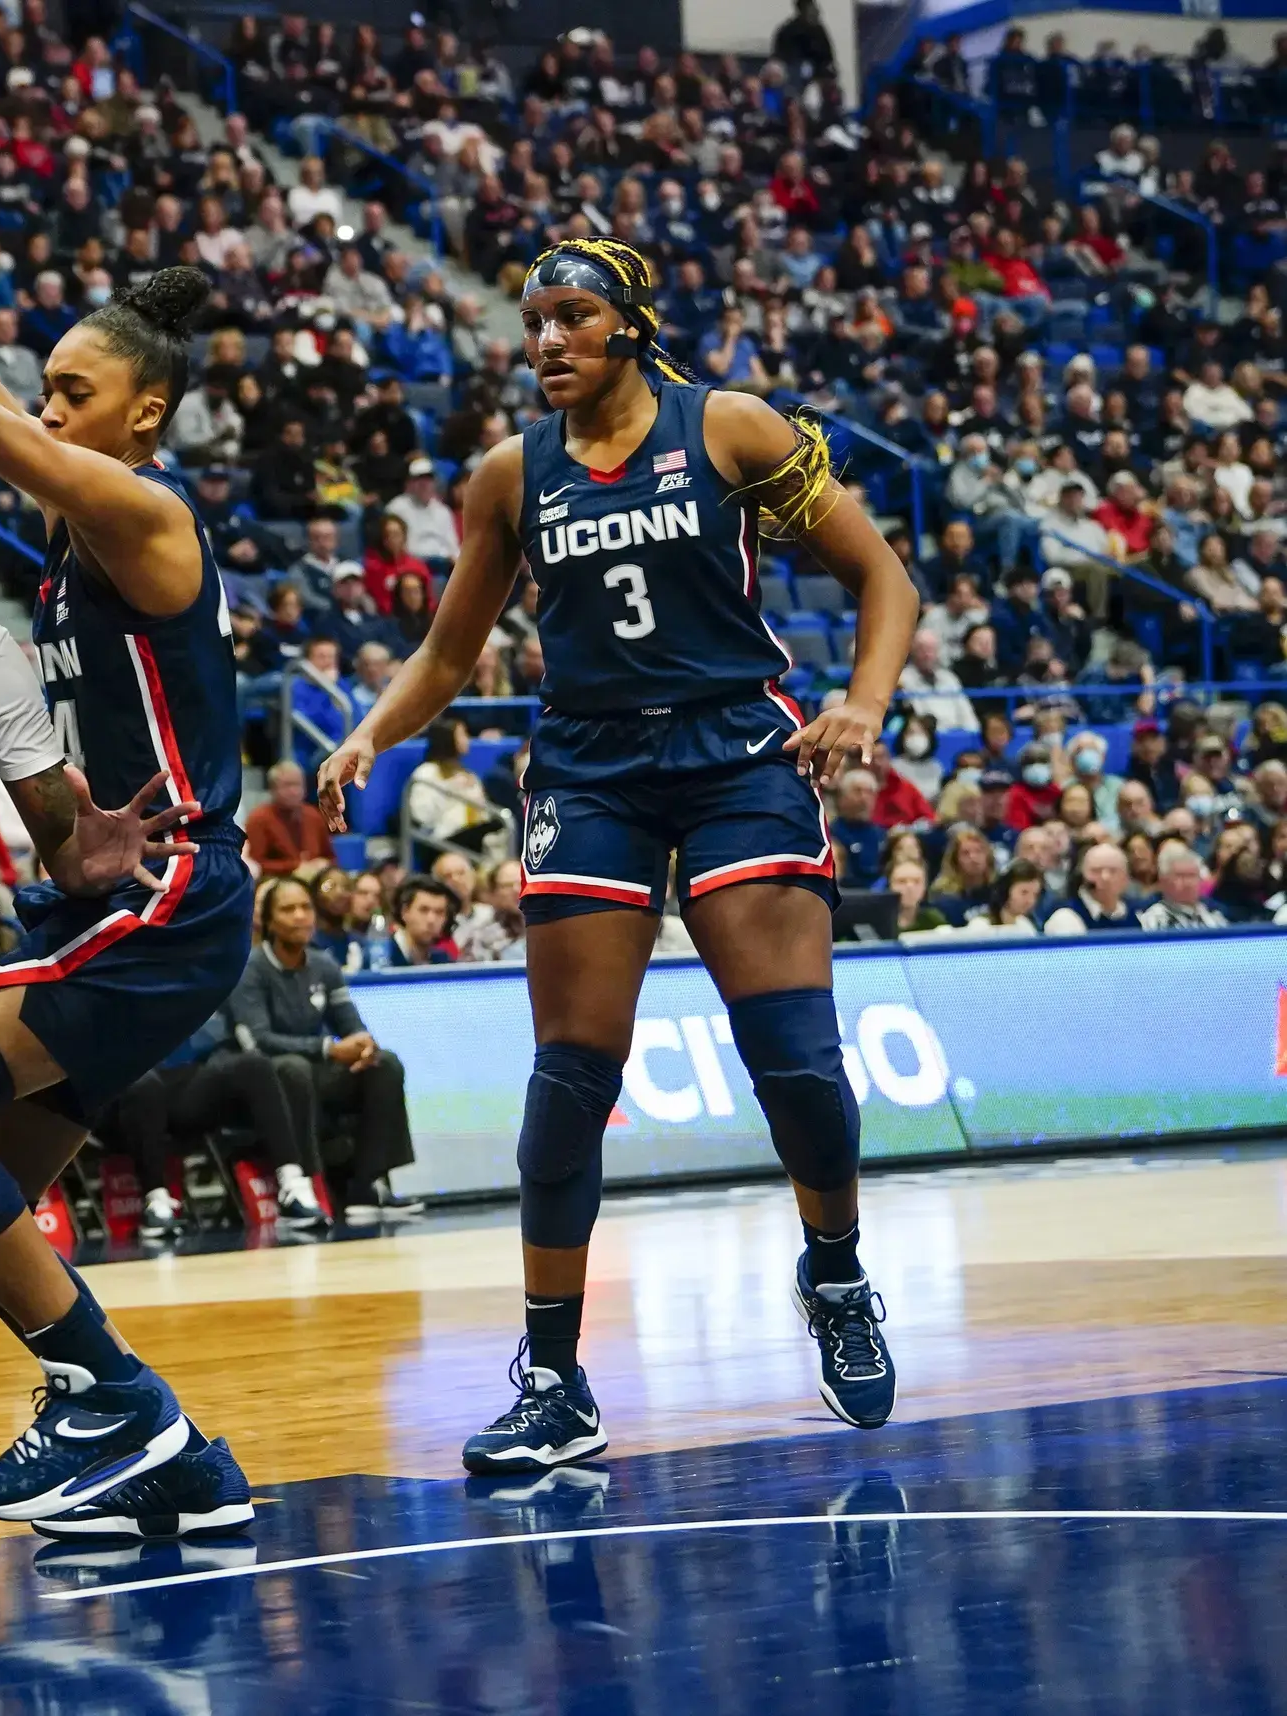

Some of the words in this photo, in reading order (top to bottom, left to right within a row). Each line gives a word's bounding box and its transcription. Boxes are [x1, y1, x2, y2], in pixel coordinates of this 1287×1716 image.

[658, 477, 693, 490] EAST
[660, 472, 685, 483] BIG
[541, 500, 701, 564] UCONN
[603, 563, 657, 640] 3
[641, 707, 672, 716] UCONN
